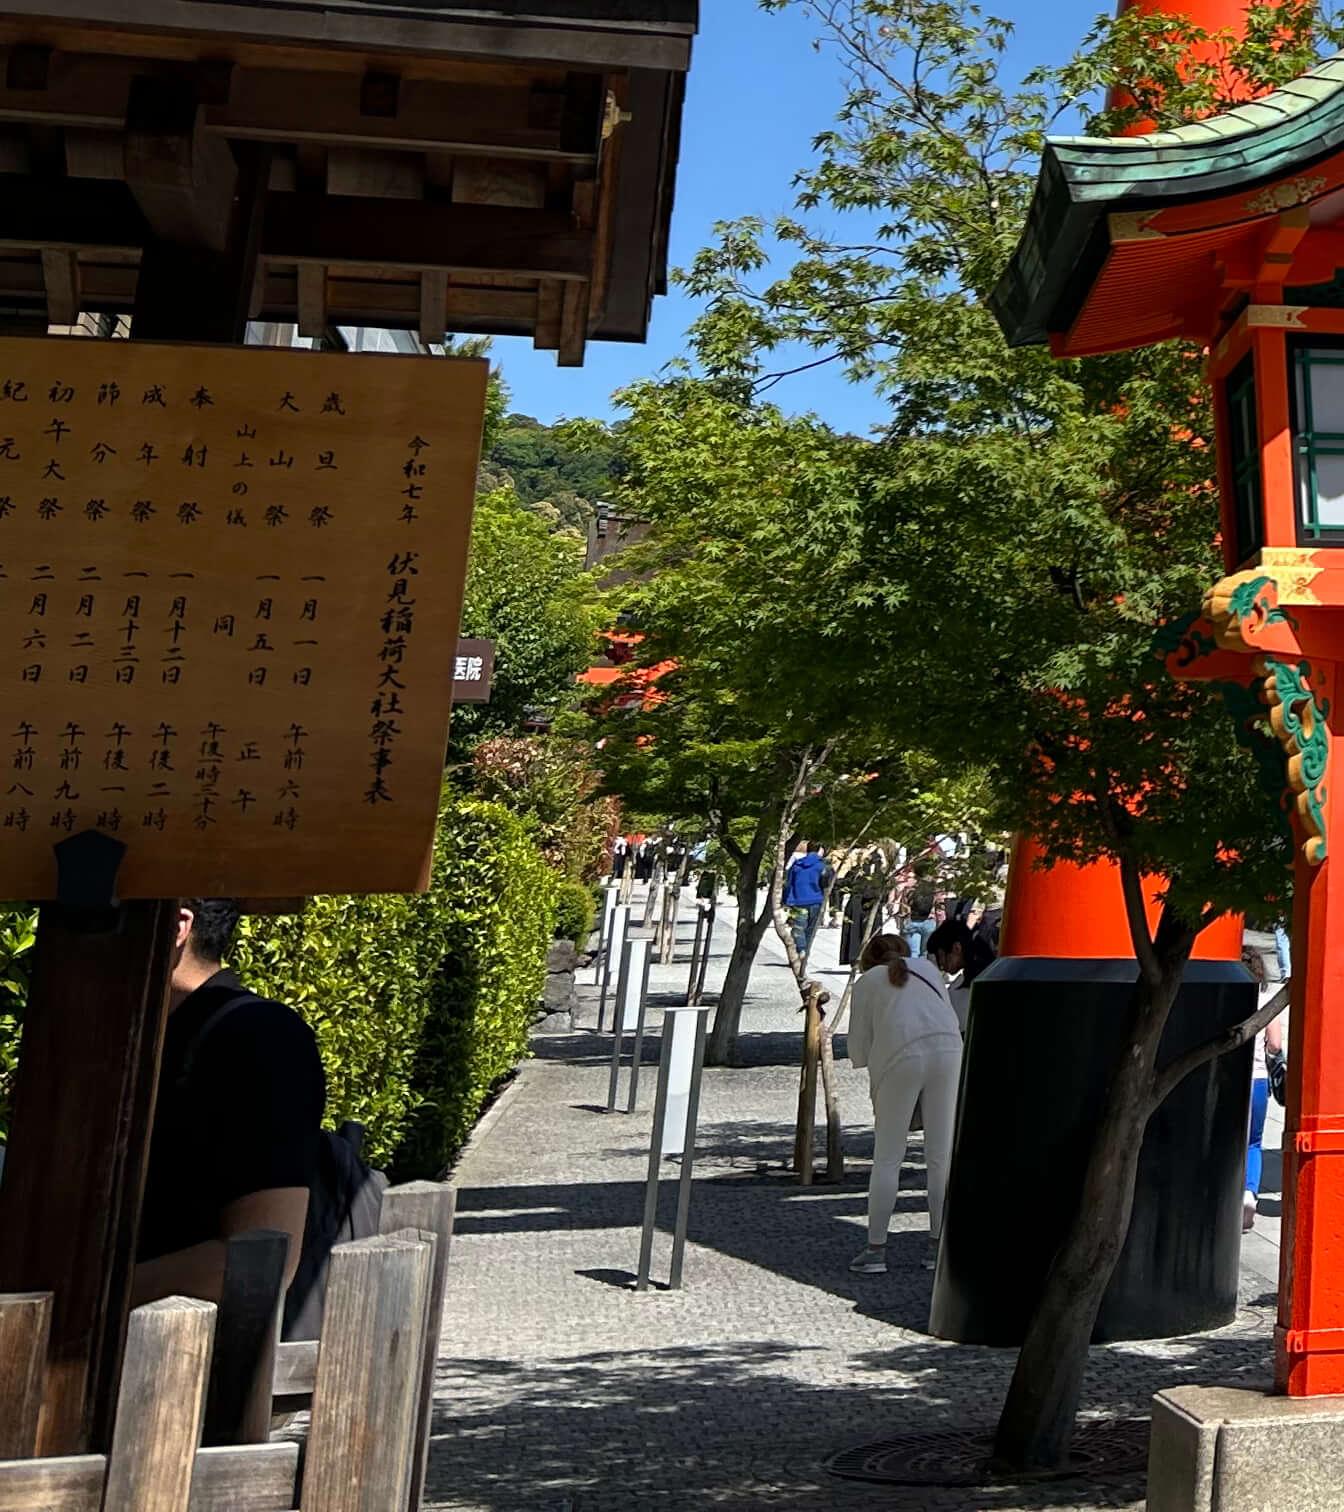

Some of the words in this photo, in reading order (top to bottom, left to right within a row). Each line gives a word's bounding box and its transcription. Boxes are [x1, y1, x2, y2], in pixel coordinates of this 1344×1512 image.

[37, 381, 74, 520] 初午大祭
[83, 382, 120, 522] 節分祭
[130, 385, 166, 523] 成年祭
[227, 424, 256, 527] 山上の儀
[264, 392, 300, 527] 大山祭
[308, 392, 345, 528] 歳旦祭
[398, 436, 430, 524] 令和七年
[23, 566, 54, 683] 二月六日
[69, 567, 101, 683] 二月二日
[112, 572, 149, 684] 一月十三日
[161, 573, 194, 684] 一月十二日
[248, 576, 280, 686] 一月五日
[293, 576, 325, 686] 一月一日
[363, 552, 419, 804] 伏見稲荷大社祭事表
[4, 721, 38, 832] 午前八時
[50, 722, 85, 832] 午前九時
[96, 722, 132, 832] 午後一時
[142, 722, 178, 831] 午後二時
[232, 742, 261, 812] 正午
[272, 723, 308, 830] 午前六時
